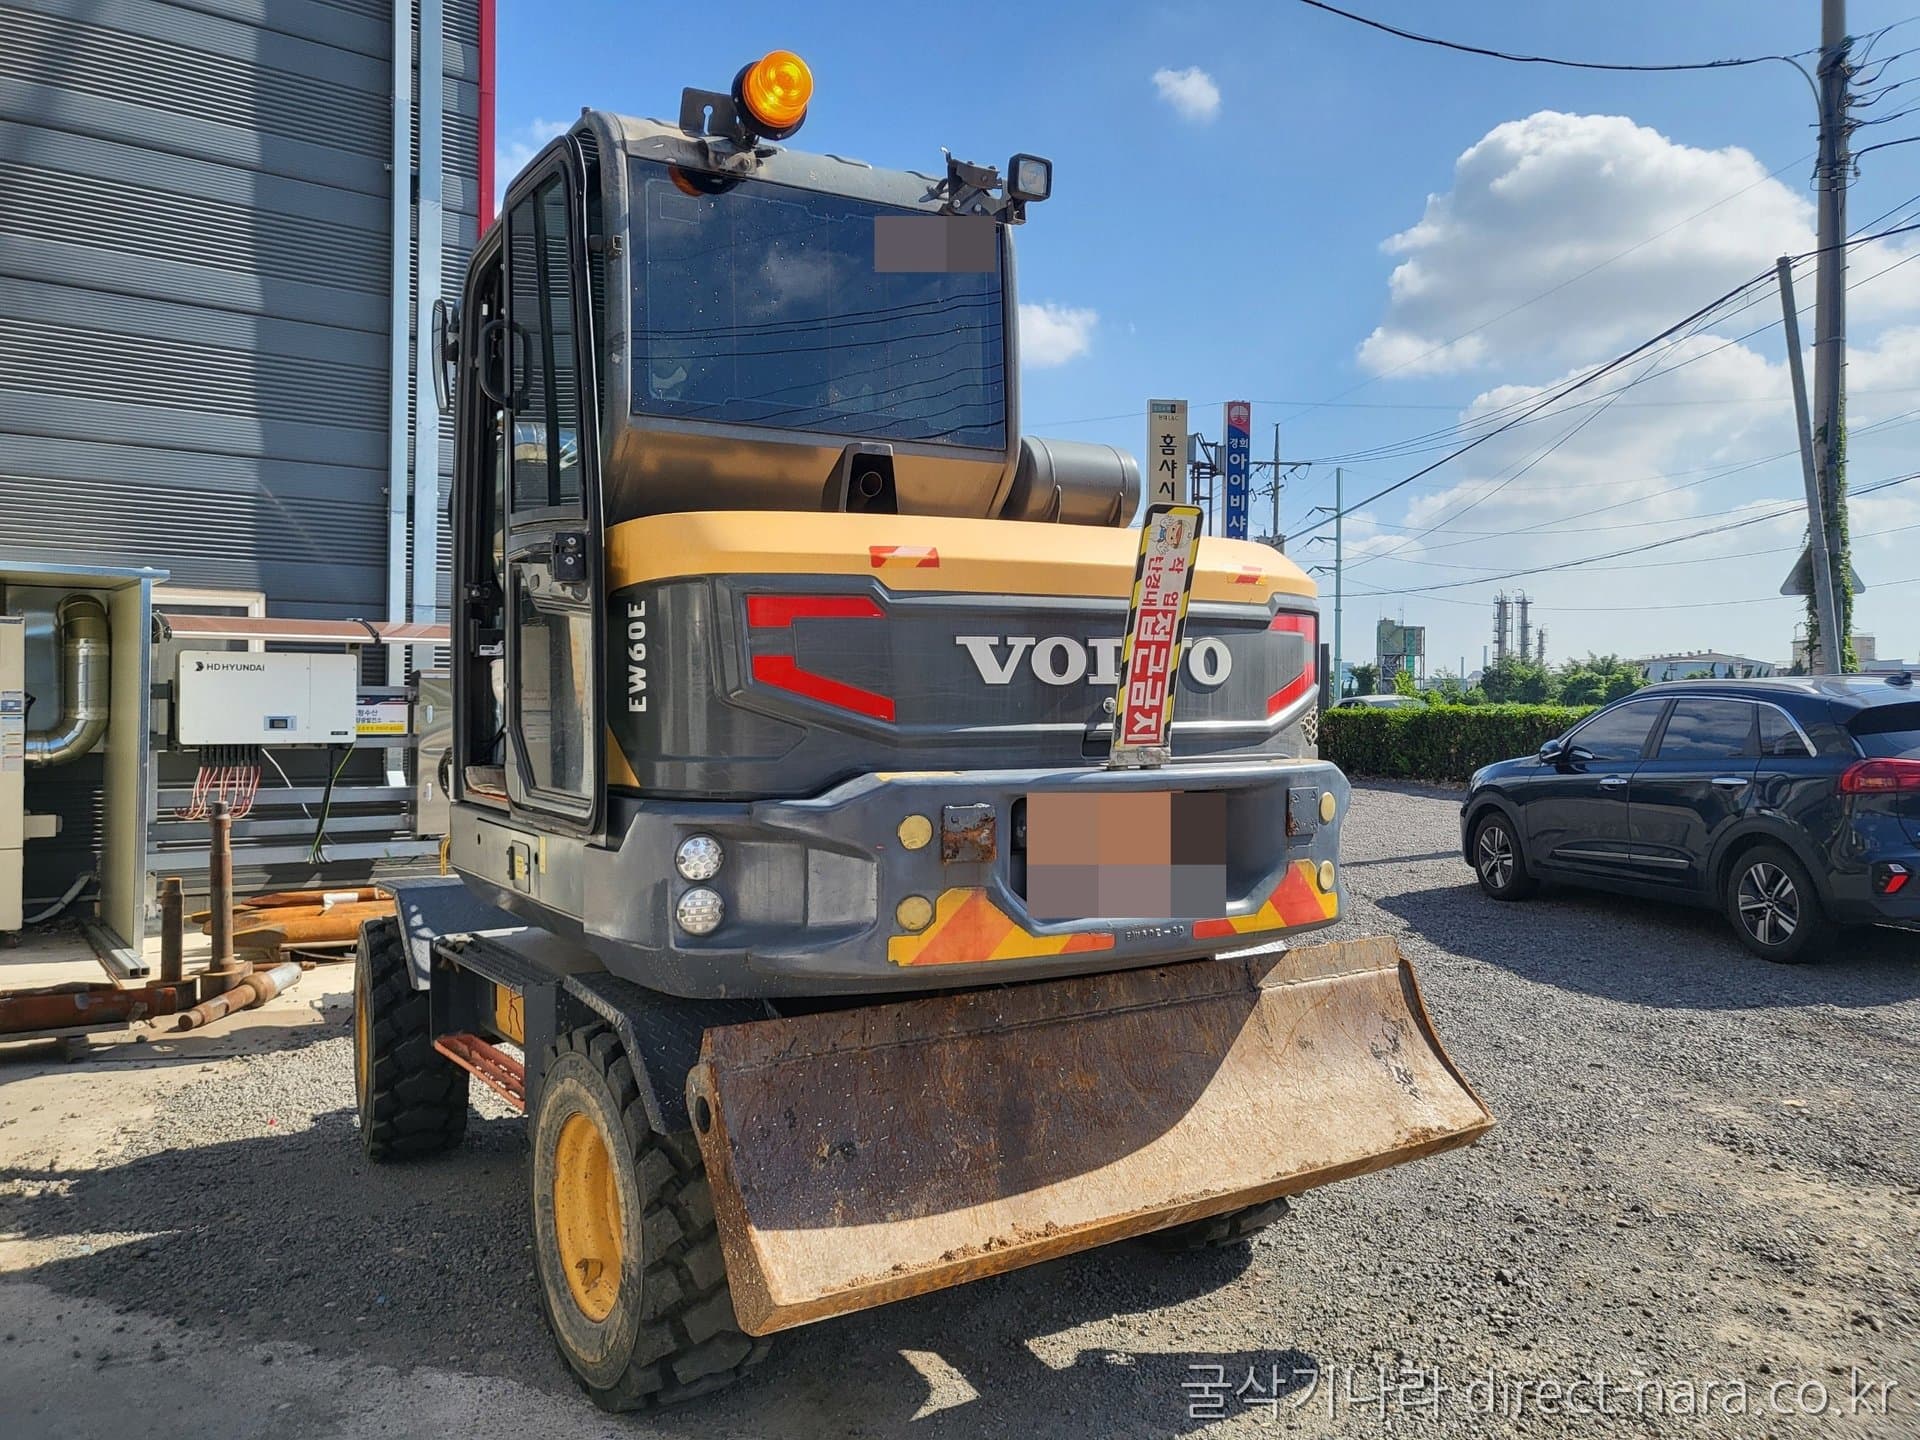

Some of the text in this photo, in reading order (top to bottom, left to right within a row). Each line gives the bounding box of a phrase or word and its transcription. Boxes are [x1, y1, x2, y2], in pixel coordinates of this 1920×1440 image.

[1159, 433, 1178, 501] 홈샤시
[1228, 453, 1247, 540] 아이비샤
[206, 663, 265, 672] HD HYUNDAI
[627, 599, 647, 713] EW60E
[955, 635, 1233, 686] VOLO
[1126, 611, 1173, 741] 접근금지
